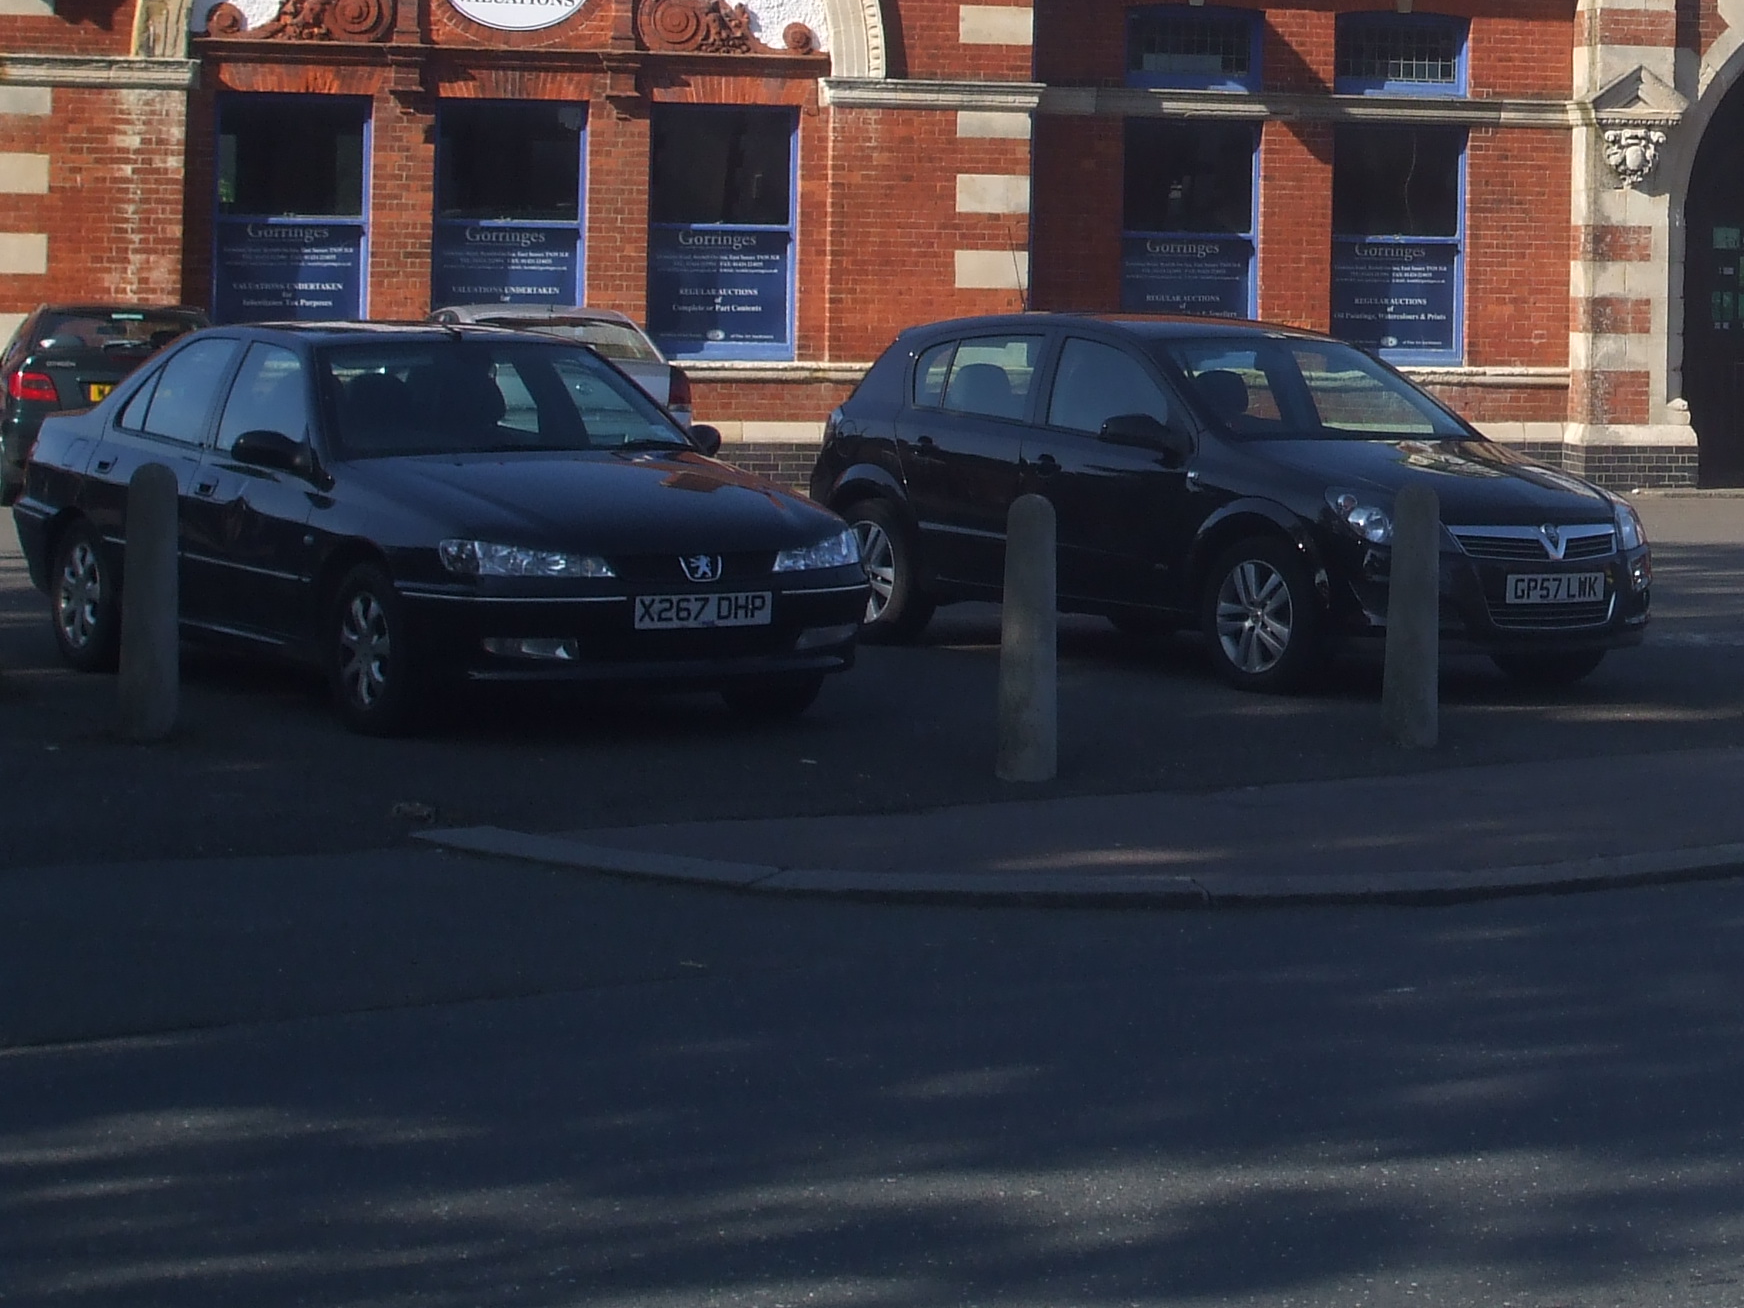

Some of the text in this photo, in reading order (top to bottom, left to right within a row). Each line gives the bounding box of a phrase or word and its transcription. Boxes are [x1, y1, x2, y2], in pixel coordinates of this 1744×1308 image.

[247, 224, 329, 242] Gorringes
[466, 227, 545, 247] Gorringes
[679, 230, 756, 250] Gorringes
[1147, 240, 1219, 258] Gorringes
[1355, 244, 1425, 261] Gorringes
[1514, 578, 1562, 600] GP57
[639, 595, 766, 622] X267 DHP
